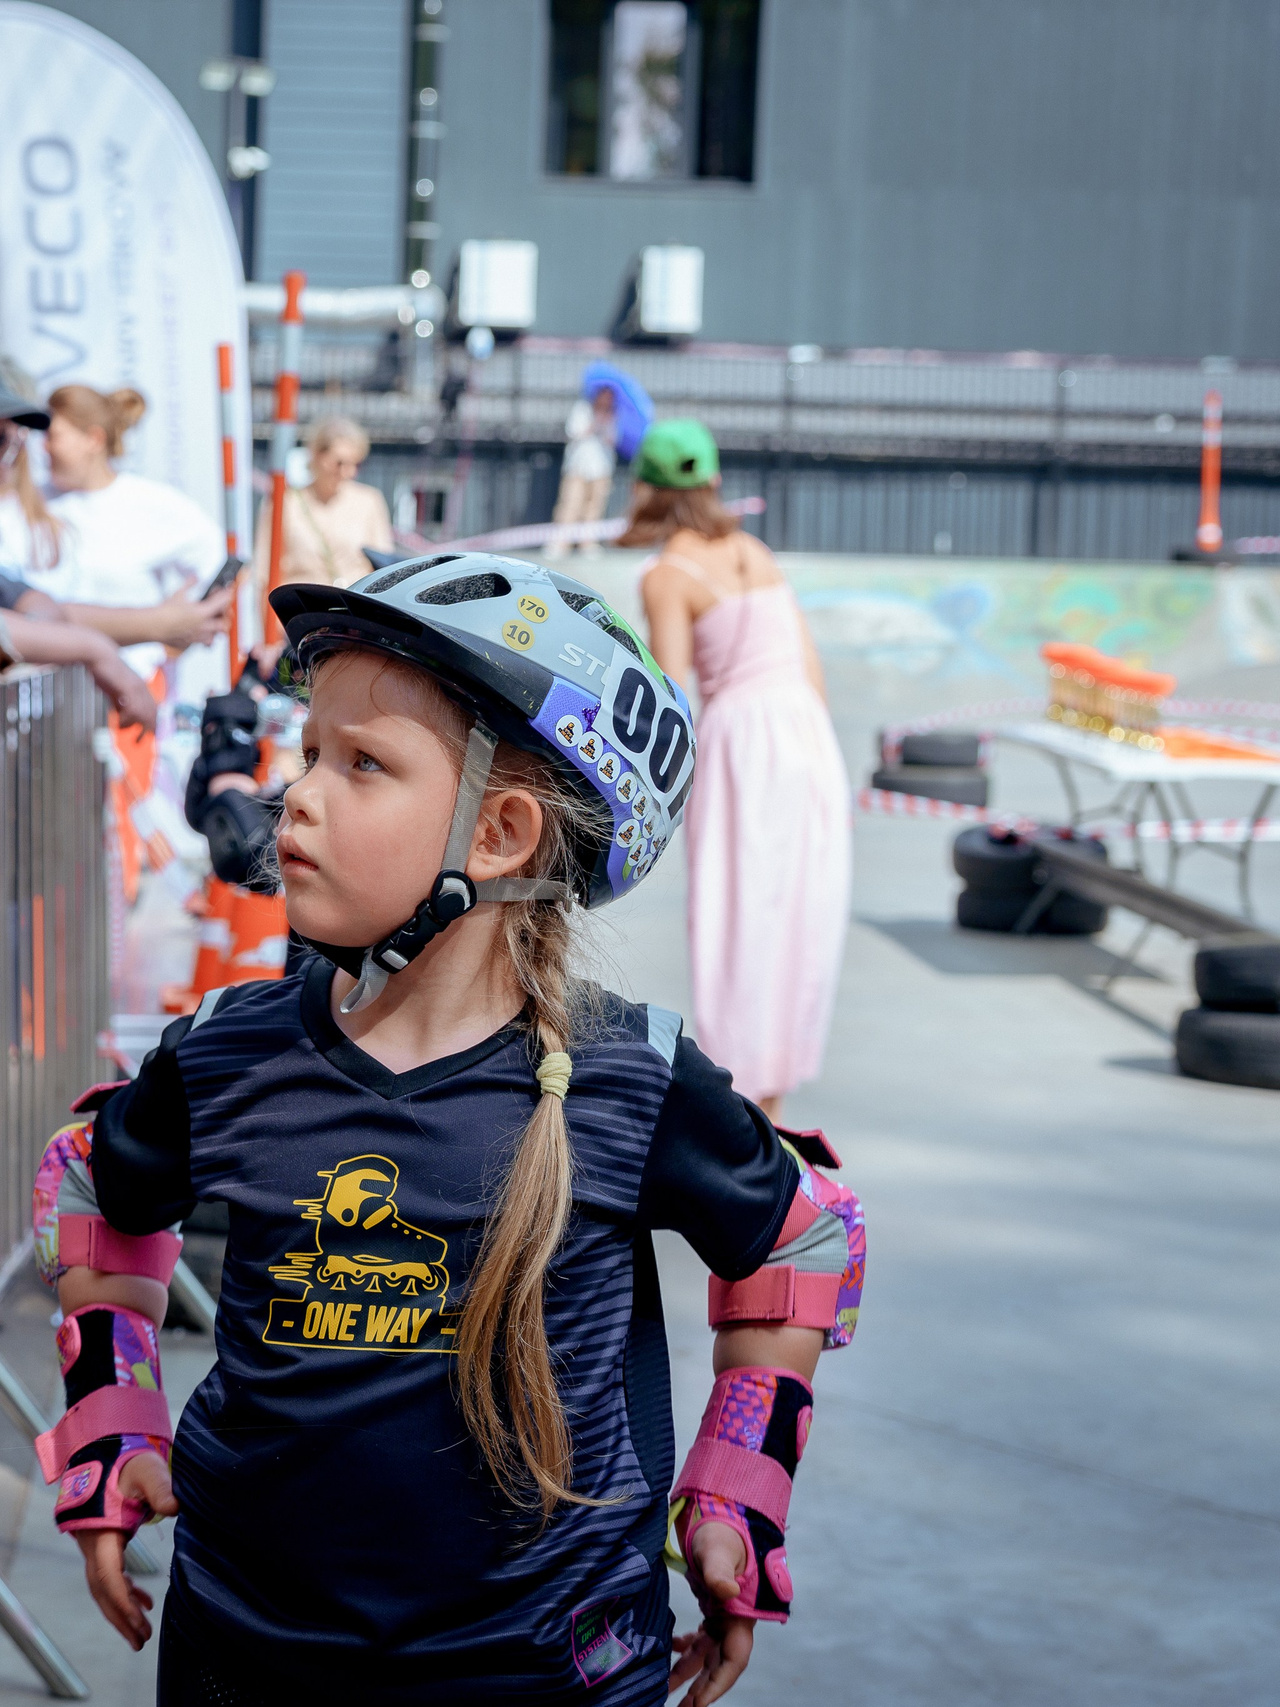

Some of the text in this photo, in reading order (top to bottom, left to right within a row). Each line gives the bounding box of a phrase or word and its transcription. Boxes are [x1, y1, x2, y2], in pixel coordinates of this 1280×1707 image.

[506, 624, 530, 646] 10
[302, 1301, 432, 1344] ONE WAY
[578, 1631, 609, 1663] SYSTEM
